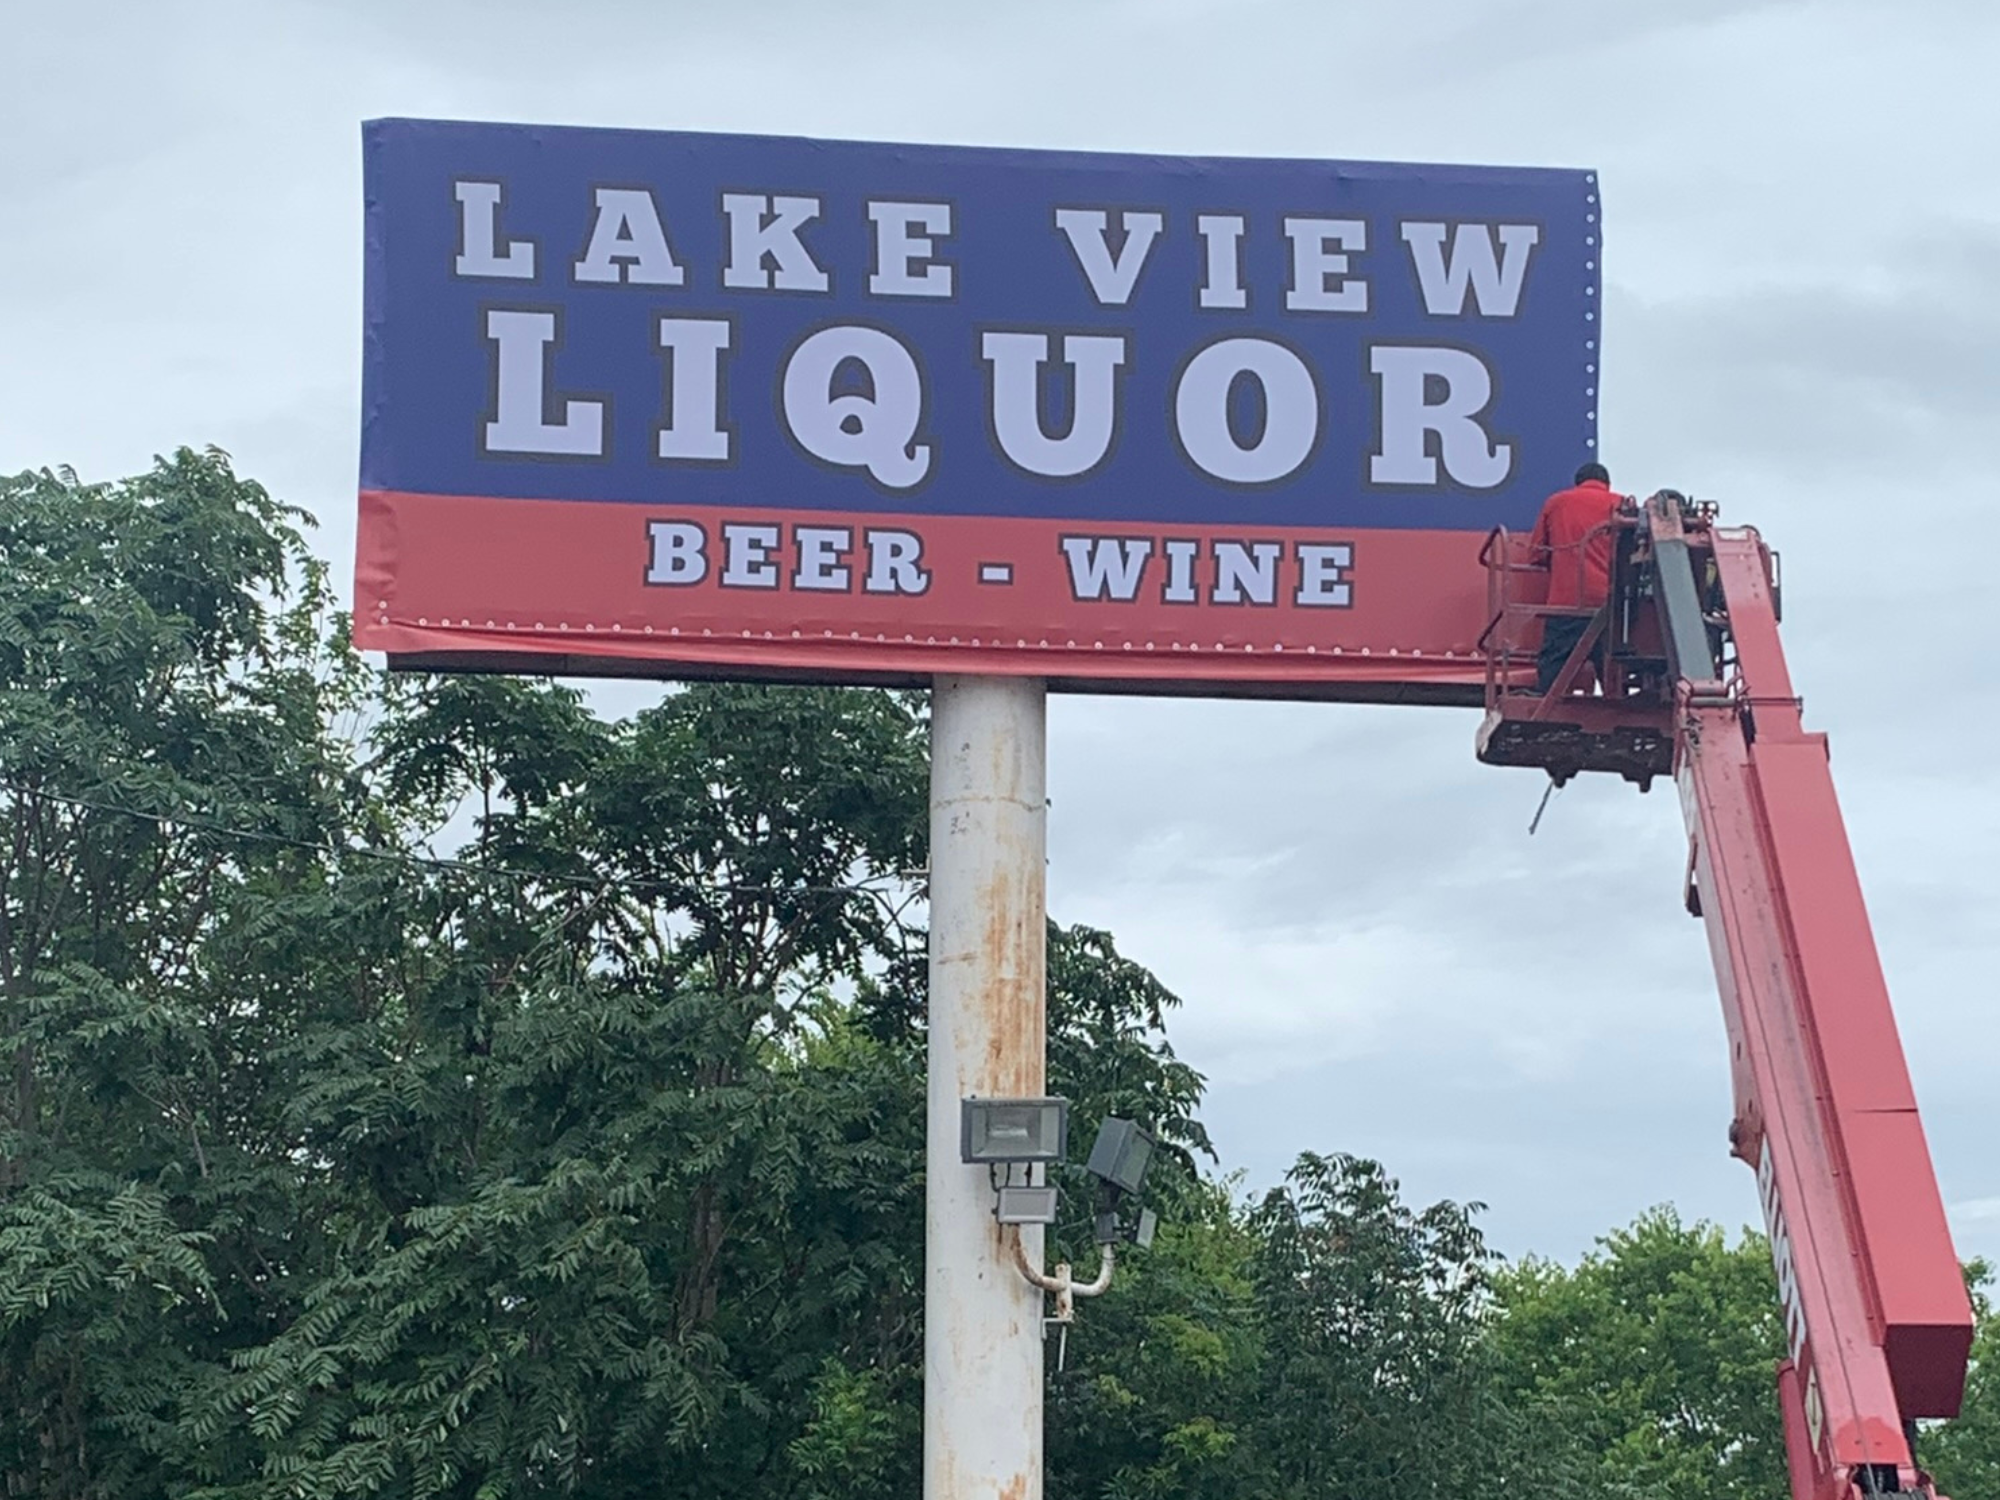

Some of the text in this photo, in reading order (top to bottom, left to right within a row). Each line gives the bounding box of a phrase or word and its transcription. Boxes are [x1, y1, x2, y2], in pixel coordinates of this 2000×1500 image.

[453, 179, 1540, 318] LAKE VIEW
[484, 308, 1513, 490] LIQUOR
[646, 521, 1353, 609] BEER - WINE
